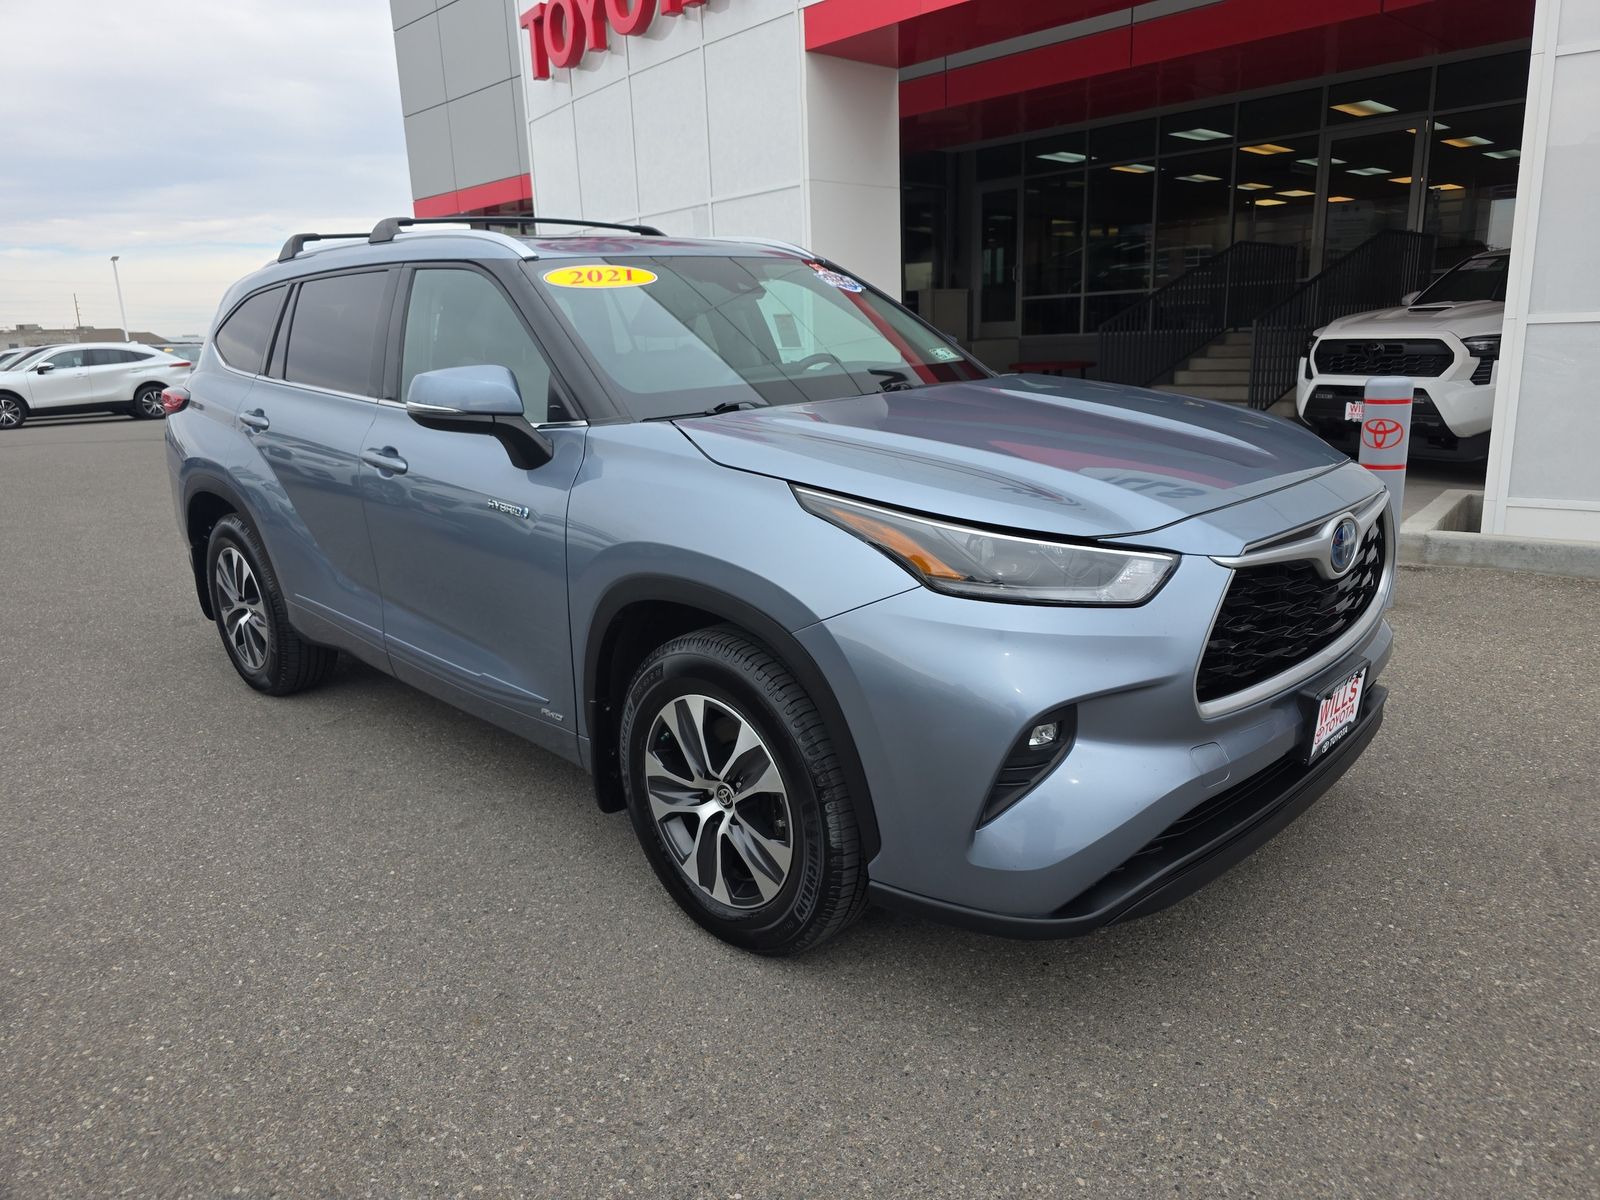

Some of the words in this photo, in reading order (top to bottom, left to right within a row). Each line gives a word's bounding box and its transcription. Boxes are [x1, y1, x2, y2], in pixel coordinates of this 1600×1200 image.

[520, 0, 709, 80] TOYO
[569, 269, 633, 284] 2021
[487, 498, 522, 517] HYBRID
[1320, 678, 1359, 726] WILLS
[1325, 704, 1355, 734] TOYOTA
